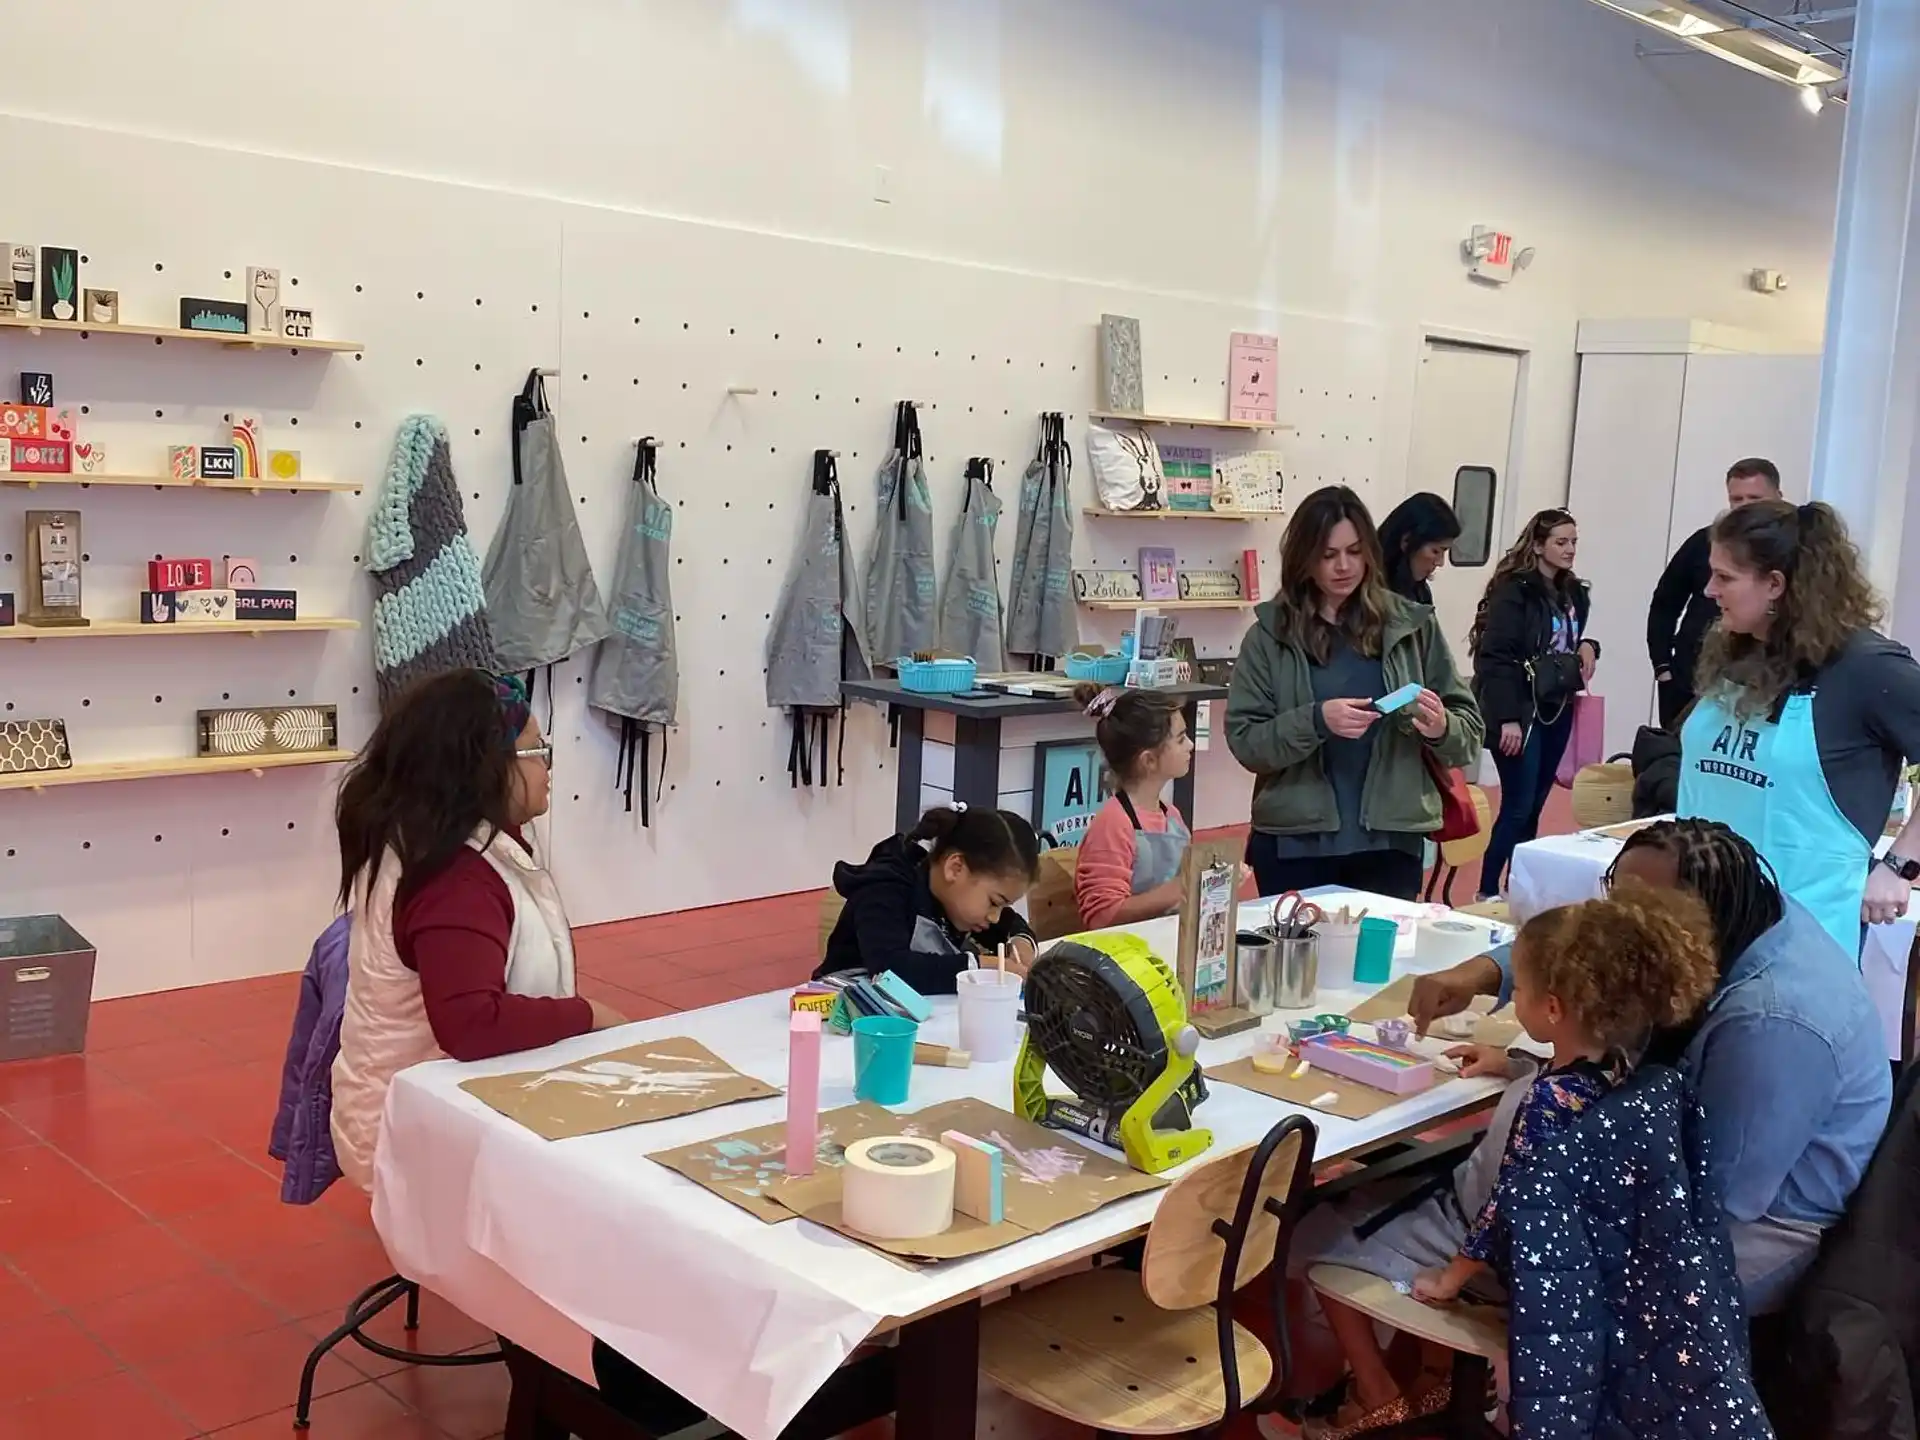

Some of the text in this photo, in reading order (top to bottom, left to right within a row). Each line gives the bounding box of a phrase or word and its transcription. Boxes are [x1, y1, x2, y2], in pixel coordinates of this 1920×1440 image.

[1487, 232, 1512, 264] XIT
[285, 324, 311, 338] CLT
[1165, 448, 1203, 460] WANTED
[204, 457, 233, 470] LKN
[261, 599, 294, 610] PWR
[1702, 760, 1763, 785] WORKSHOP
[1056, 815, 1096, 835] WORK
